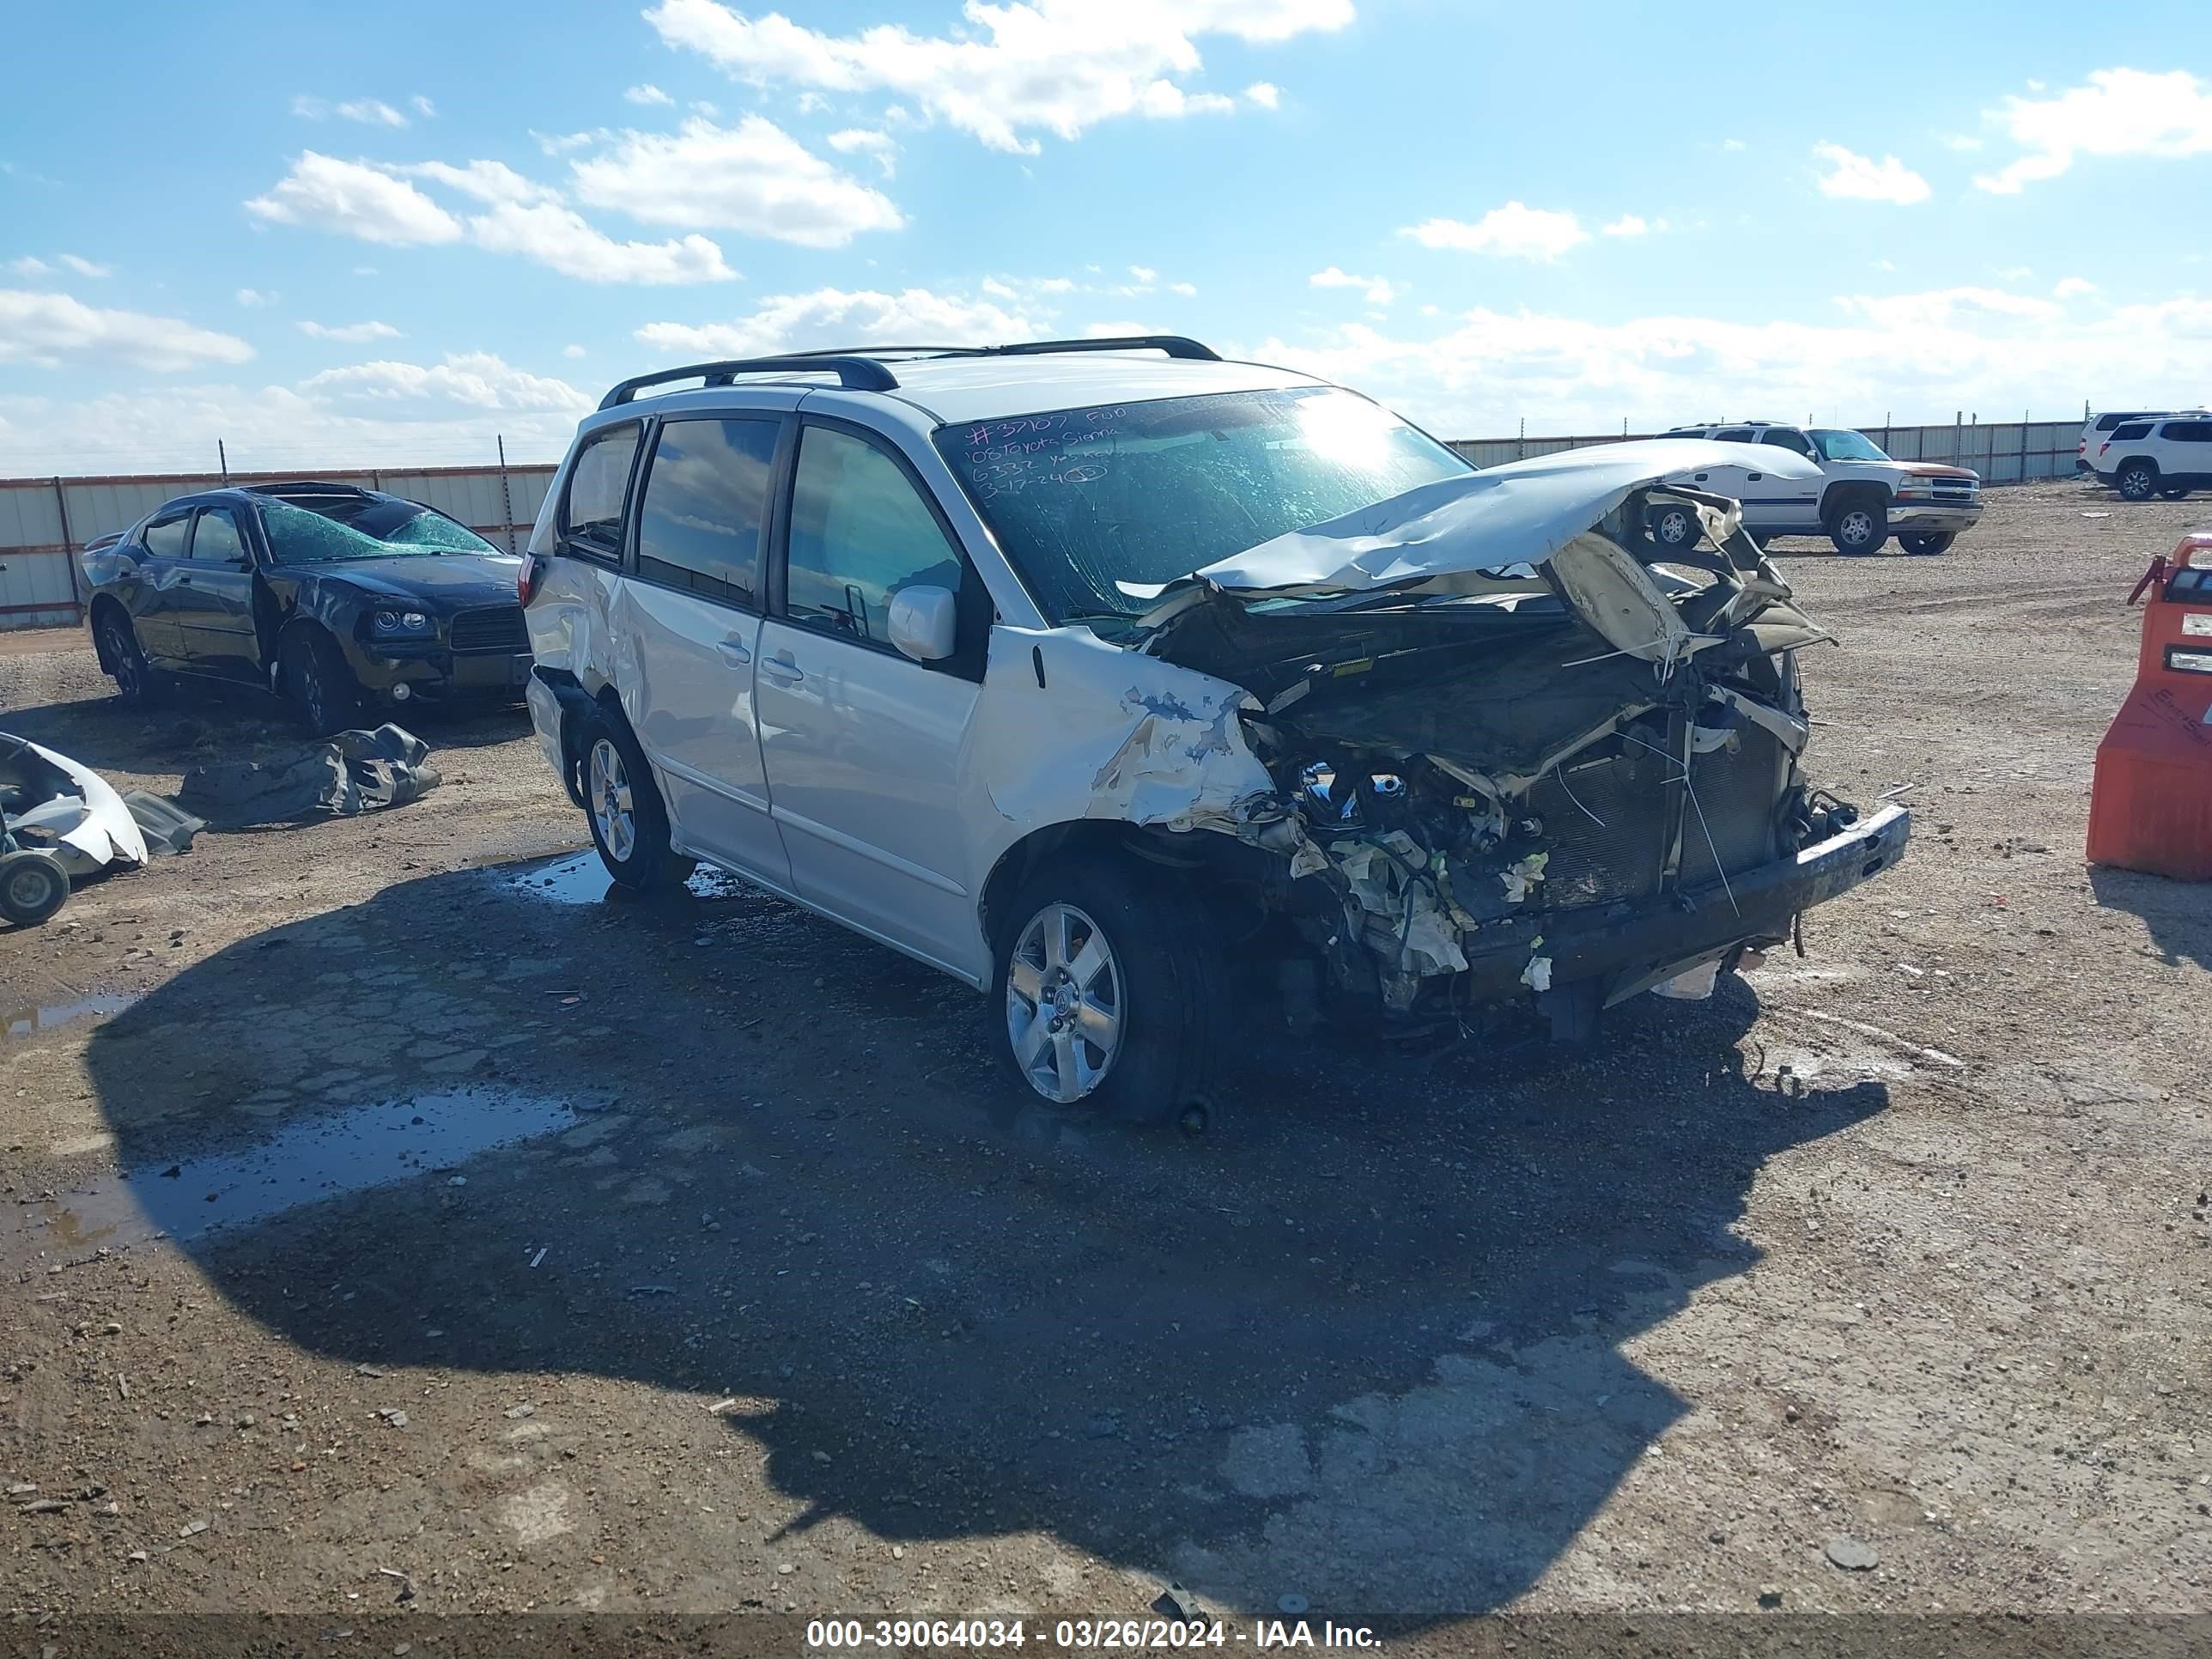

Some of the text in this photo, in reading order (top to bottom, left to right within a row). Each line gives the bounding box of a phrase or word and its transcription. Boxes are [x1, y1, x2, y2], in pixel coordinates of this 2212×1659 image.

[964, 415, 1067, 446] #37107
[972, 460, 1038, 483] 6332
[979, 473, 1066, 500] 3-17-24
